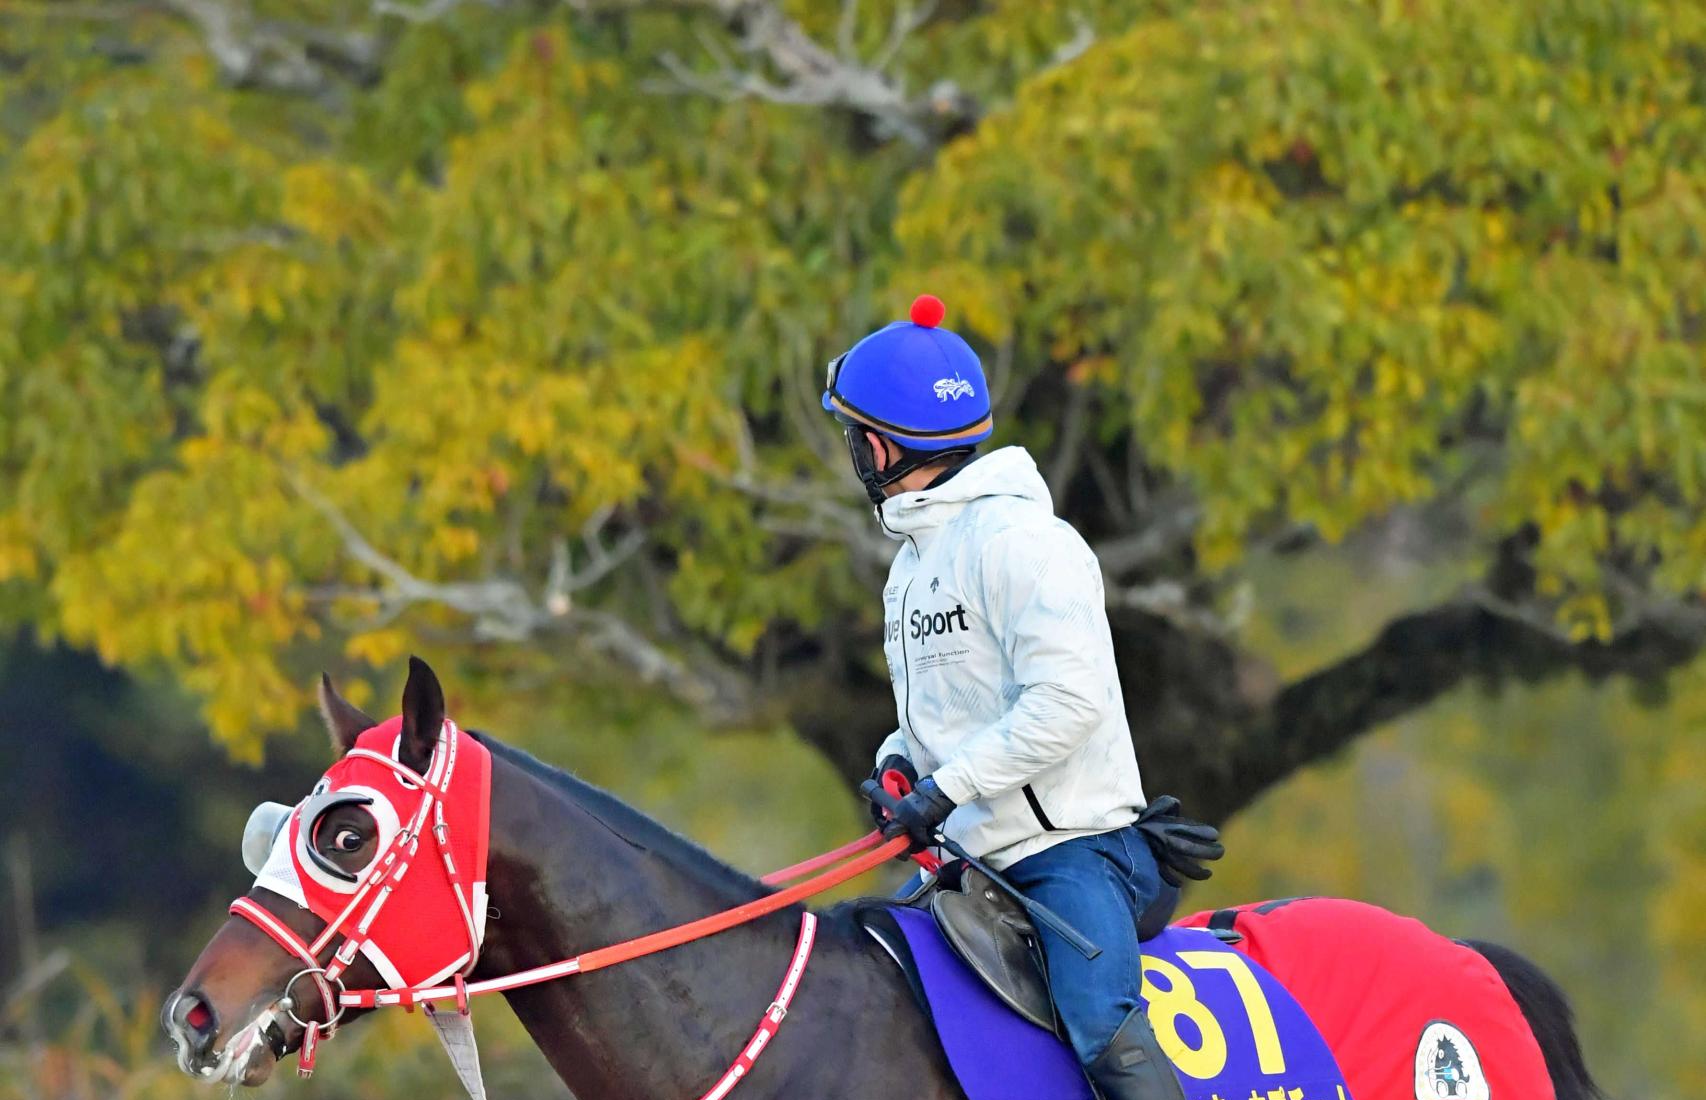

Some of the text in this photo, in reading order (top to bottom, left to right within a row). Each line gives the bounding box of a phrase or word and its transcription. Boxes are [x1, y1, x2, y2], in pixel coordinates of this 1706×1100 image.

[910, 604, 969, 646] Sport
[938, 649, 970, 658] function
[1140, 951, 1286, 1080] 87
